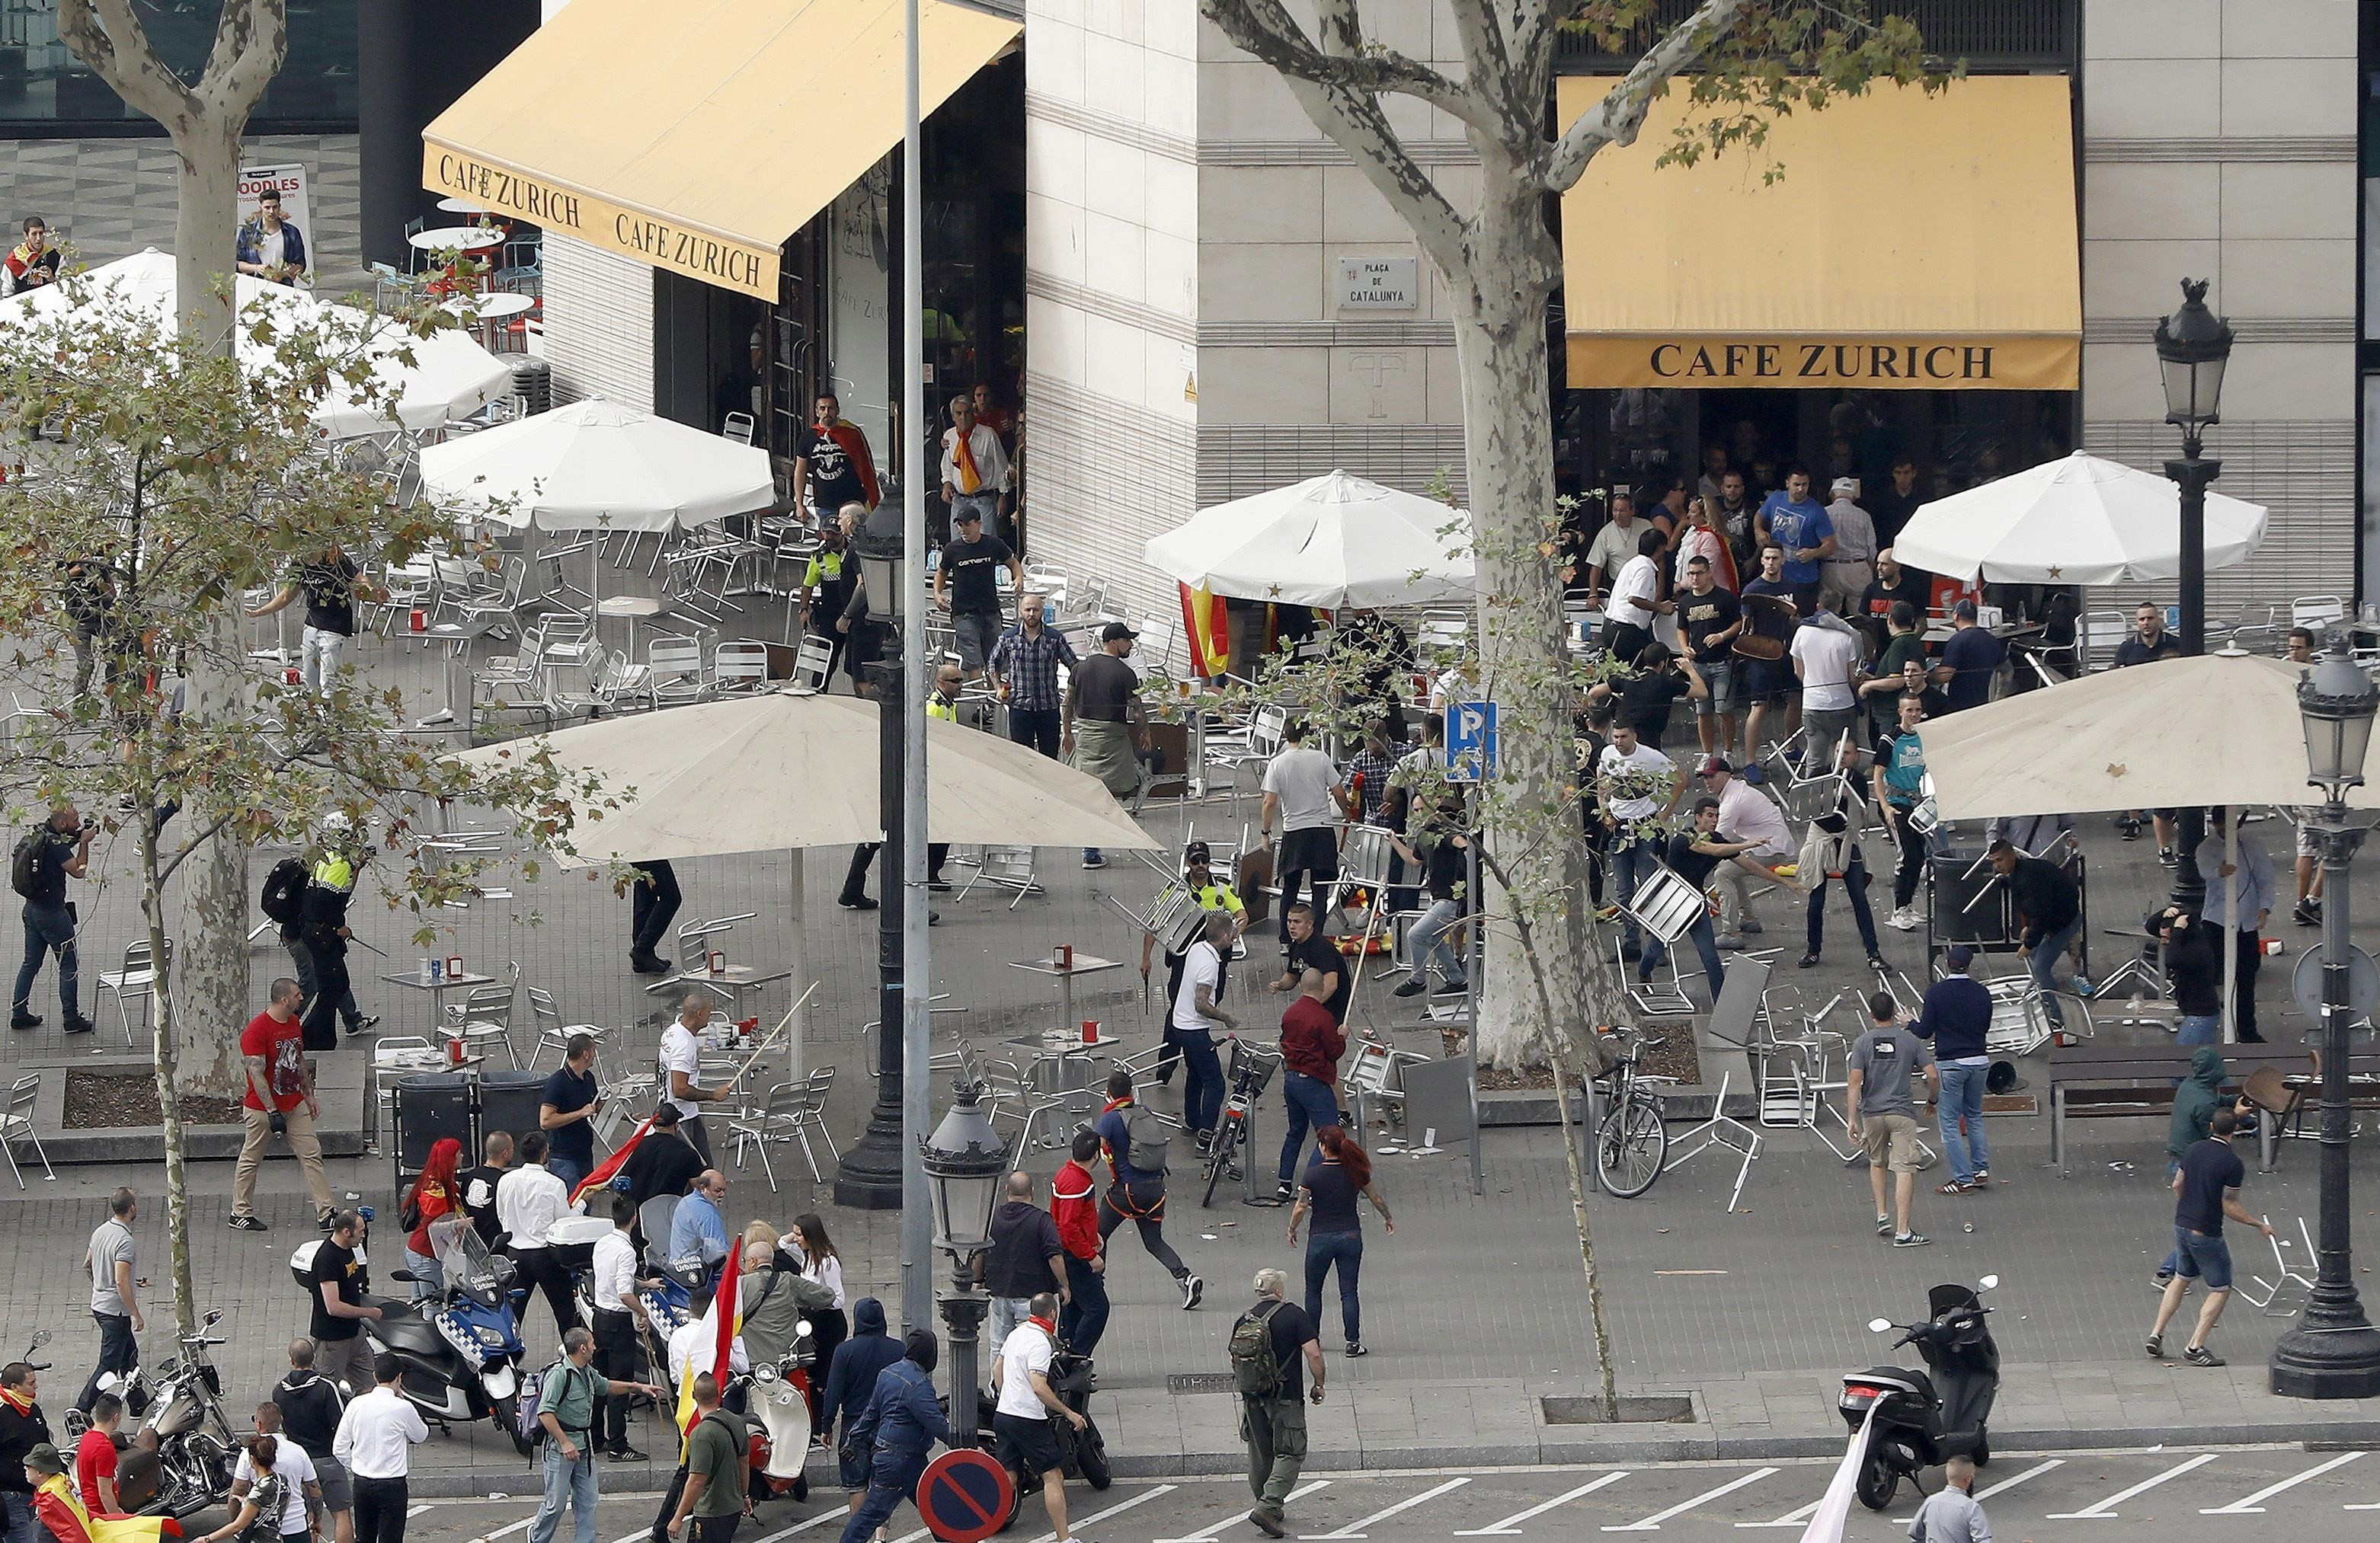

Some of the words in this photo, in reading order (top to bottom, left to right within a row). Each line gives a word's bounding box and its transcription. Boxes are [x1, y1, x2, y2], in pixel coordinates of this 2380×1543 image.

[237, 178, 299, 193] OODLES
[440, 154, 491, 200] CAFE
[497, 173, 581, 228] ZURICH
[616, 213, 669, 259] CAFE
[674, 232, 761, 288] ZURICH
[1364, 264, 1390, 273] PLAÇA
[1372, 277, 1382, 286] DE
[1350, 291, 1404, 302] CATALUNYA
[1651, 344, 1782, 377] CAFE
[1797, 345, 1995, 379] ZURICH
[1460, 711, 1484, 740] P
[675, 1263, 702, 1273] Urbana
